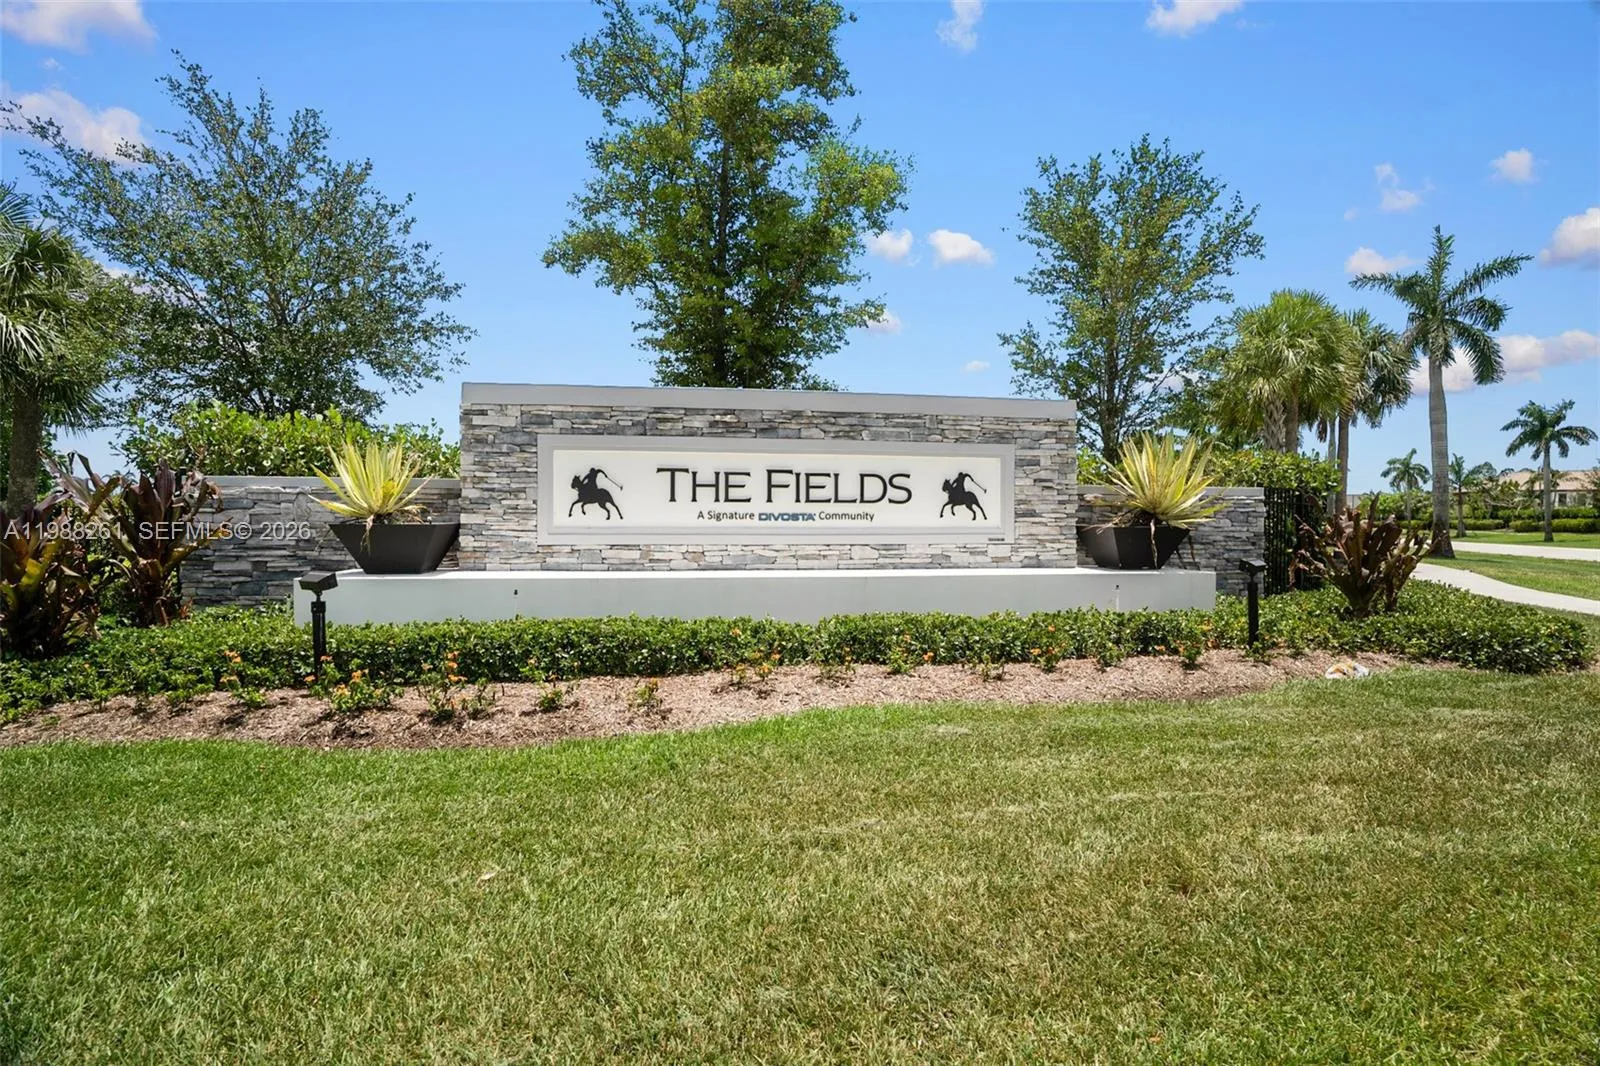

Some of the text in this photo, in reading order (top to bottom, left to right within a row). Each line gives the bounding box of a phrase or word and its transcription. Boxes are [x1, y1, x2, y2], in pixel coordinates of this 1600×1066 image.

[656, 467, 913, 504] THE FIELDS
[697, 511, 704, 520] A
[707, 511, 755, 523] Signature
[818, 511, 875, 523] Community
